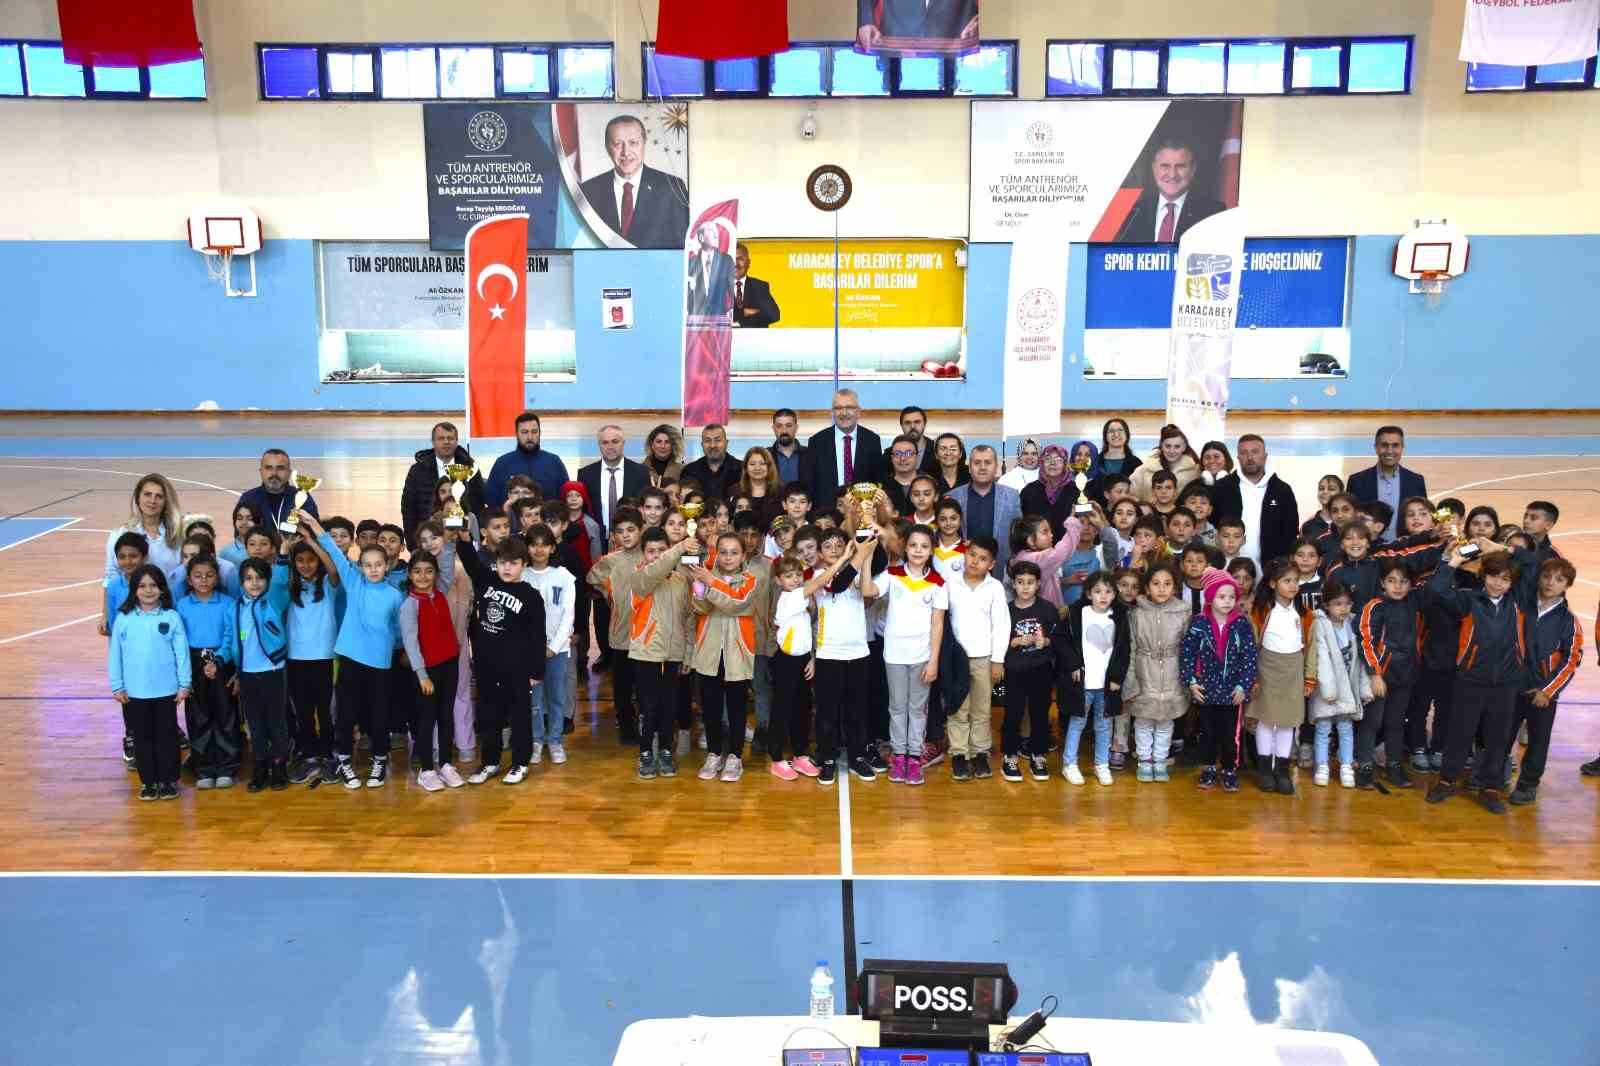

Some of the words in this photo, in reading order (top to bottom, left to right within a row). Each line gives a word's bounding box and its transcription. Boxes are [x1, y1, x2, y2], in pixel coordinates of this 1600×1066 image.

[447, 161, 471, 173] TÜM
[474, 161, 532, 173] ANTRENÖR
[435, 174, 449, 184] VE
[451, 173, 544, 184] SPORCULARIMIZA
[1000, 174, 1022, 184] TÜM
[1024, 174, 1078, 184] ANTRENÖR
[438, 186, 490, 196] BAŞARILAR
[490, 185, 542, 195] DİLİYORUM
[988, 184, 1001, 193] VE
[992, 194, 1037, 203] BAŞARILAR
[495, 204, 526, 212] ERDOĞAN
[347, 254, 372, 273] TÜM
[374, 256, 442, 273] SPORCULARA
[445, 256, 465, 276] BAŞ
[788, 253, 851, 270] KARACABEY
[854, 251, 903, 270] BELEDİYE
[905, 252, 943, 270] SPOR'A
[1104, 252, 1134, 271] SPOR
[1137, 249, 1170, 271] KENTİ
[1251, 249, 1323, 274] HOŞGELDİNİZ
[813, 273, 871, 292] BAŞARILAR
[874, 271, 918, 289] DİLERİM
[438, 286, 464, 294] ÖZKAN
[1178, 304, 1233, 318] KARACABEY
[895, 985, 974, 1011] POSS.
